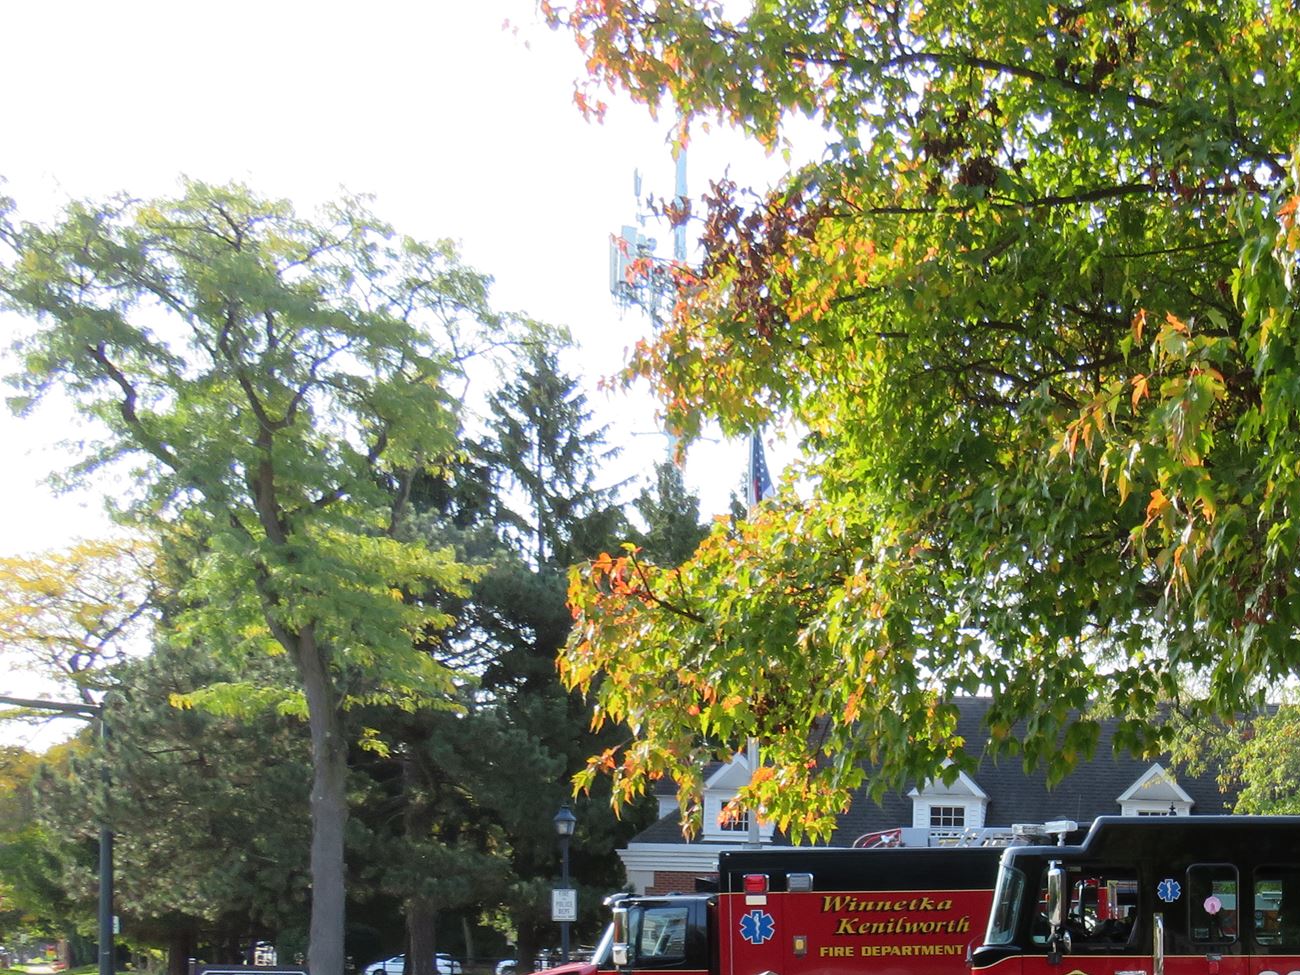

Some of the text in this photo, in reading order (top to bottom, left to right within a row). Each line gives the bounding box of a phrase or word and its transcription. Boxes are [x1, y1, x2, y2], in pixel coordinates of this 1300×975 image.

[821, 895, 953, 913] Winnetka
[835, 915, 970, 936] Kenilworth
[820, 944, 964, 957] FIRE DEPARTMENT
